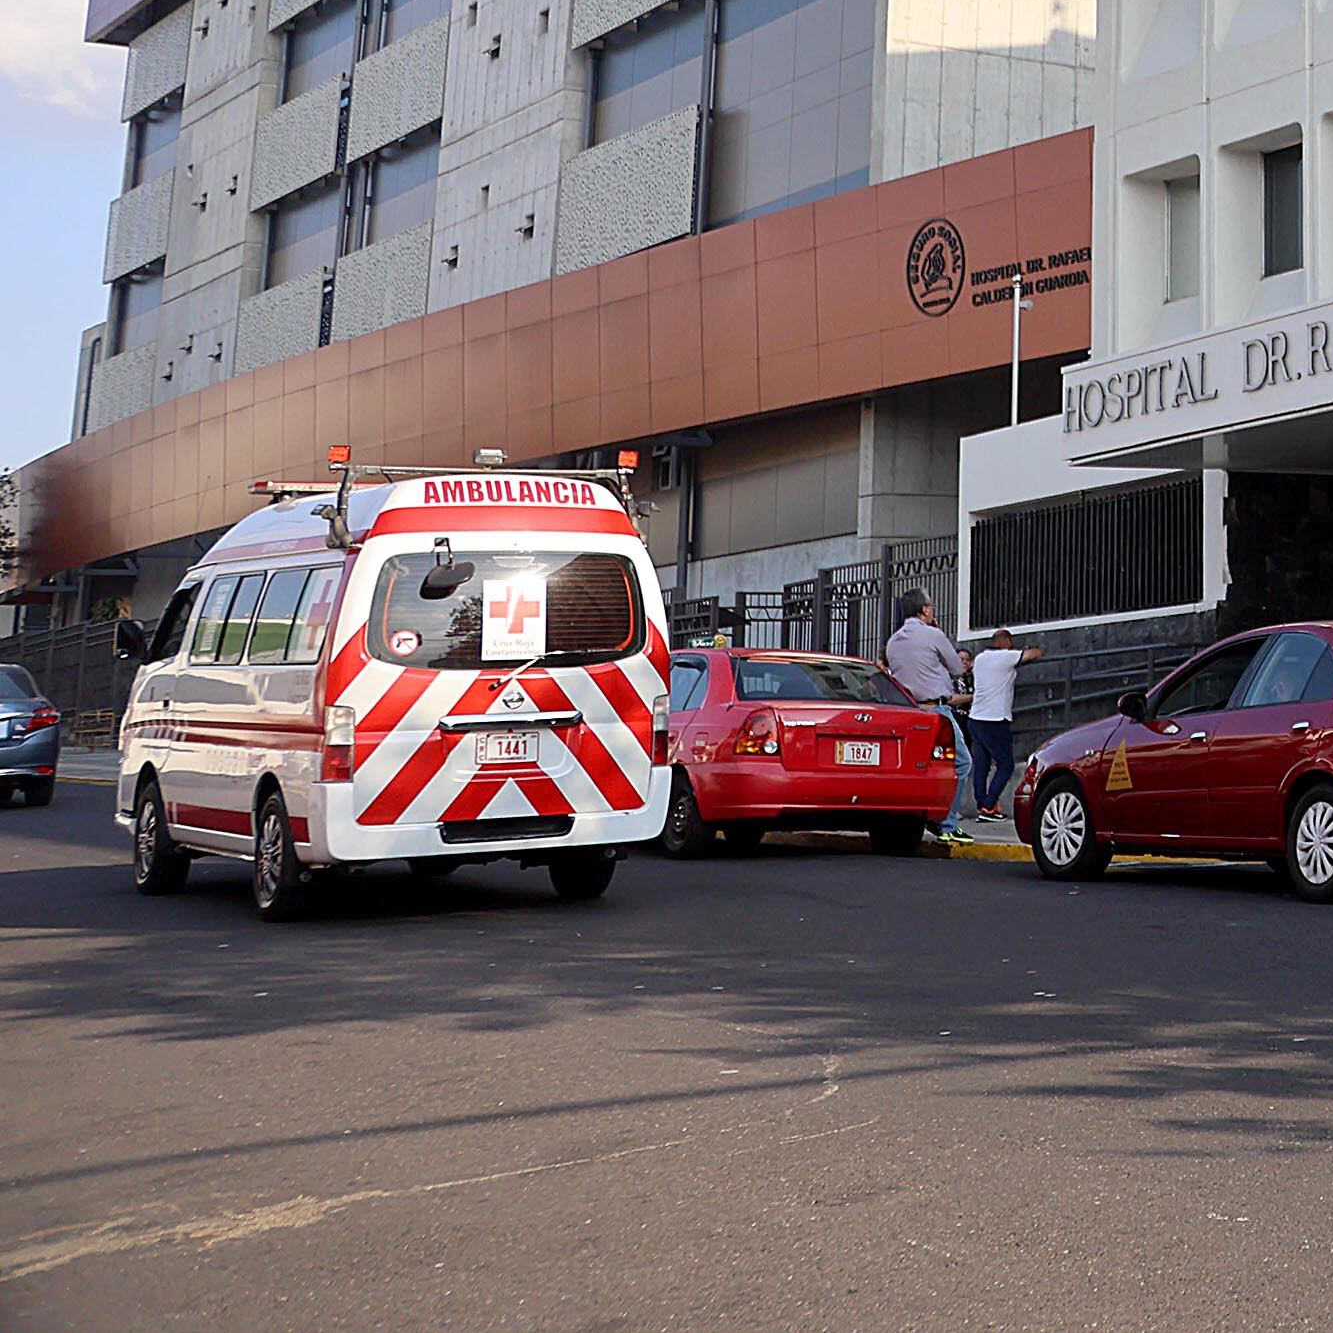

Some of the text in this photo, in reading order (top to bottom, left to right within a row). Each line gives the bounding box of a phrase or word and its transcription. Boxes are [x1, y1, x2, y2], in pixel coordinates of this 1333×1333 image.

[970, 262, 1025, 287] HOSPITAL
[1026, 257, 1047, 274] DR.
[1035, 269, 1089, 294] GUARDIA
[1063, 352, 1219, 433] HOSPITAL
[424, 480, 596, 505] AMBULANCIA
[497, 740, 528, 756] 1441
[851, 747, 872, 760] 1847
